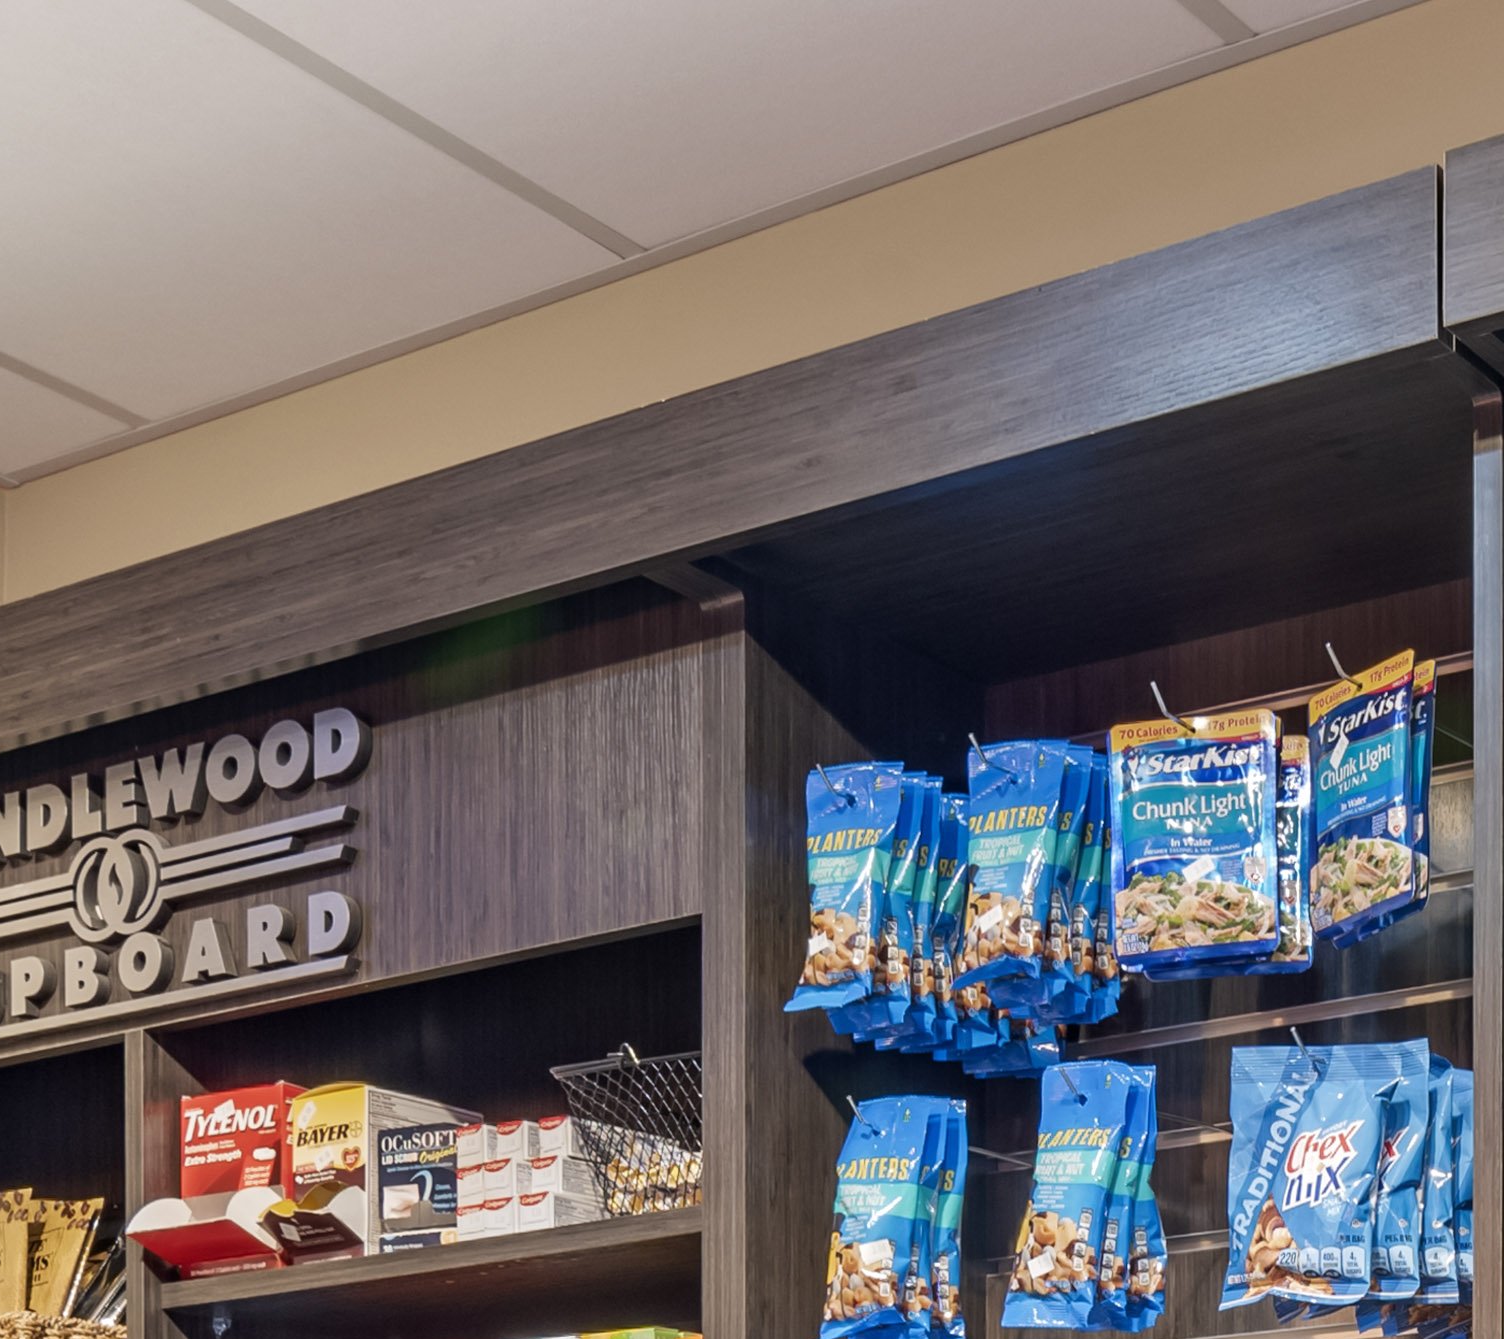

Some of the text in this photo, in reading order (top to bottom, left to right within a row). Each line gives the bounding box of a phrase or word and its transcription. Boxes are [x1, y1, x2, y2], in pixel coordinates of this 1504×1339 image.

[1314, 699, 1323, 710] 70
[1324, 685, 1351, 706] Calories
[1384, 656, 1410, 678] Protein
[1119, 729, 1134, 740] 70
[1136, 724, 1178, 738] Calories
[1146, 742, 1262, 776] StarKist
[1320, 743, 1392, 793] Chunk Light
[1338, 774, 1368, 795] TUNA
[1132, 791, 1246, 821] Chunk Light
[1170, 836, 1213, 848] In Water
[184, 1104, 279, 1143] TYLENOL
[297, 1123, 349, 1147] BAYER
[1286, 1122, 1362, 1173] Chex
